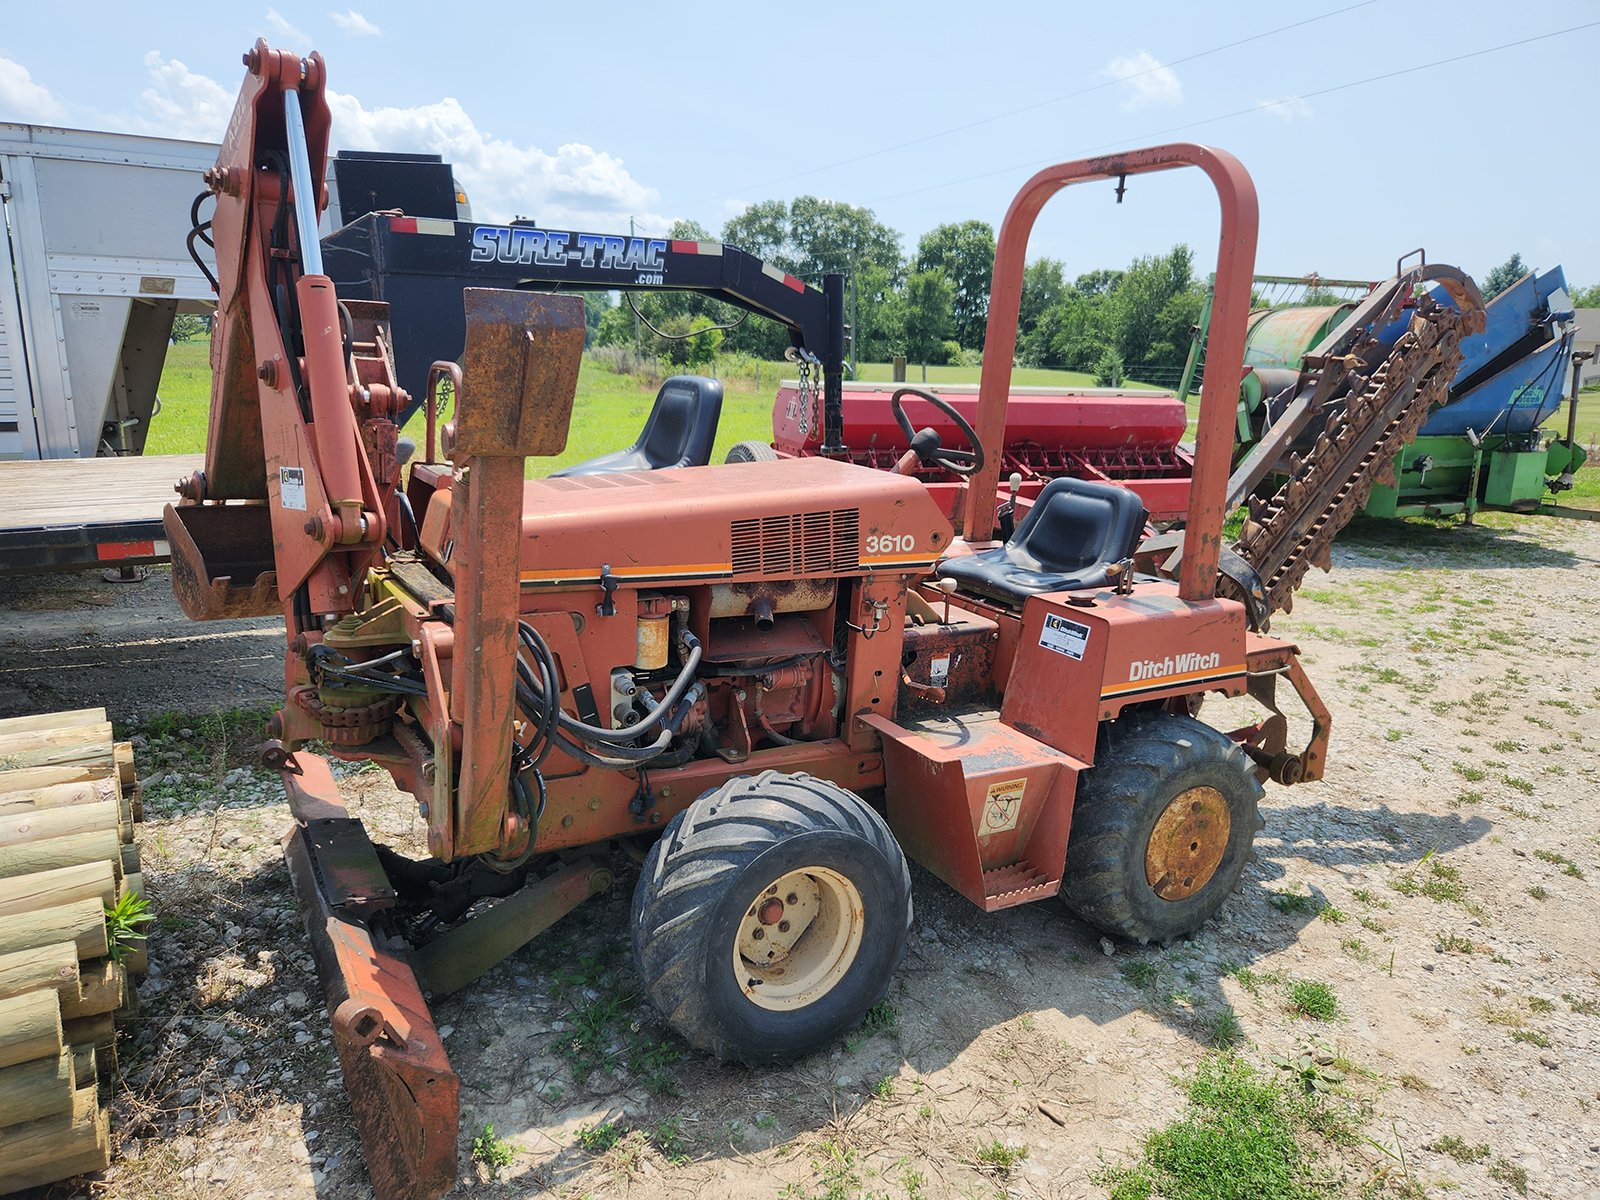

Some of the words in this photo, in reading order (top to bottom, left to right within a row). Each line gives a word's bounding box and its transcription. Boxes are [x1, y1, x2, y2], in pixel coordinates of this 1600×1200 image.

[471, 226, 667, 272] SURE-TRAC
[634, 272, 664, 286] .com
[865, 534, 915, 553] 3610
[1128, 656, 1174, 682] Ditch
[1175, 652, 1220, 674] Witch
